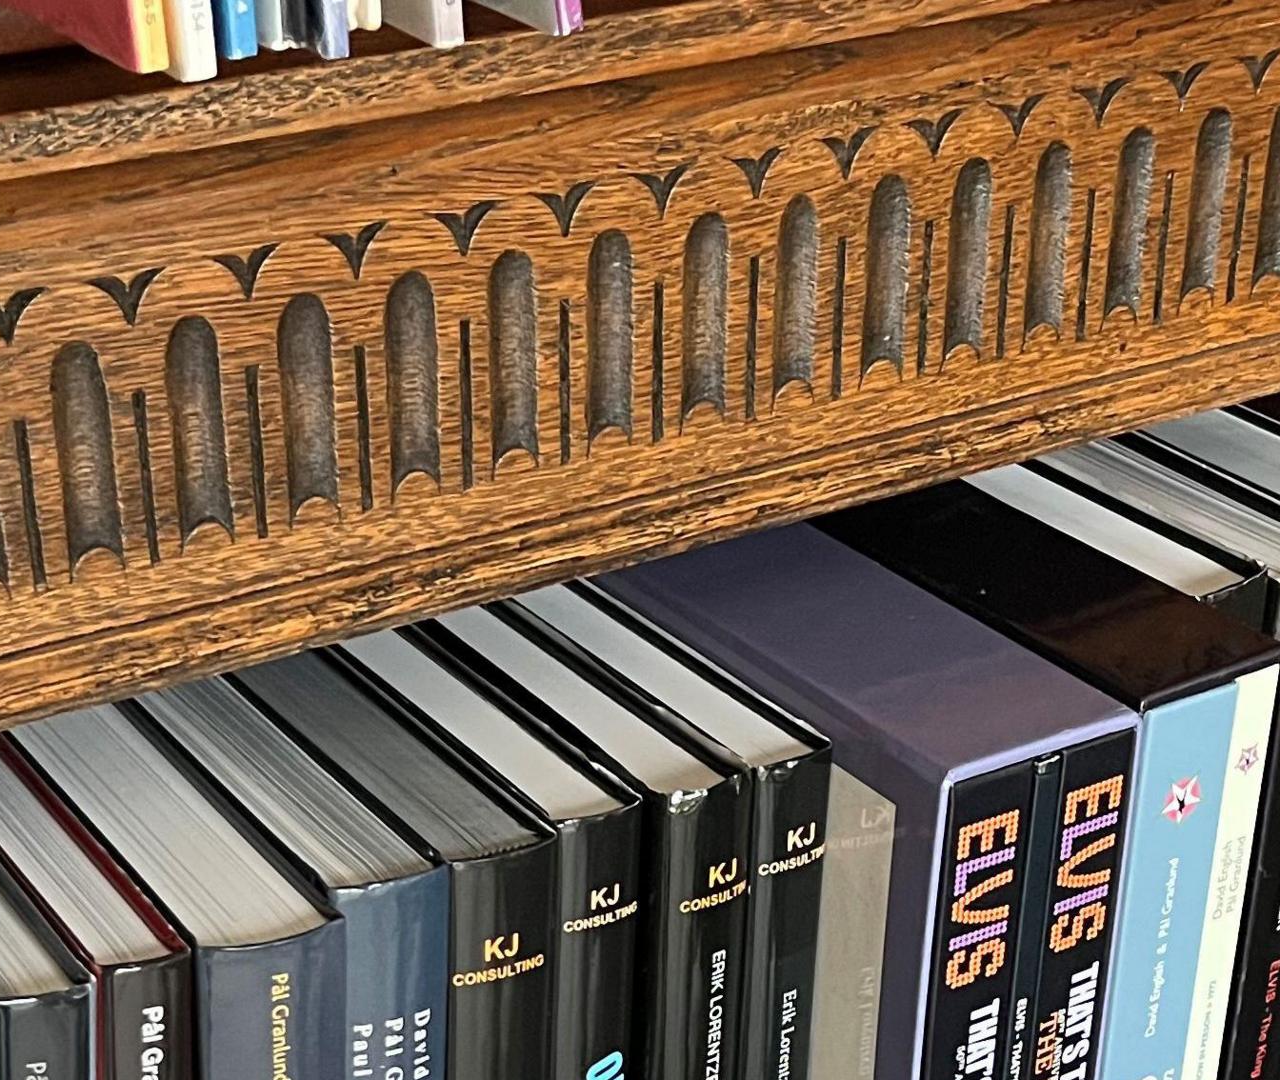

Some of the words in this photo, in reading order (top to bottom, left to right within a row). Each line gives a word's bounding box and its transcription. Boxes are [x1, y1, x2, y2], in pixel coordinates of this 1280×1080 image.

[786, 822, 816, 852] KJ
[708, 858, 738, 888] KJ
[1049, 774, 1124, 954] ELVIS
[590, 883, 620, 910] KJ
[945, 809, 1019, 990] ELVIS
[563, 901, 637, 933] CONSULTING
[483, 933, 520, 962] KJ
[453, 954, 544, 987] CONSULTING
[710, 949, 726, 990] ERIK
[140, 1005, 165, 1043] Pål
[782, 988, 797, 1027] Erik
[1062, 960, 1100, 1065] THAT'S
[413, 1008, 431, 1080] David
[1035, 1011, 1059, 1075] THE
[1262, 1013, 1273, 1042] The
[353, 1023, 374, 1076] Paul
[1254, 1041, 1269, 1080] King
